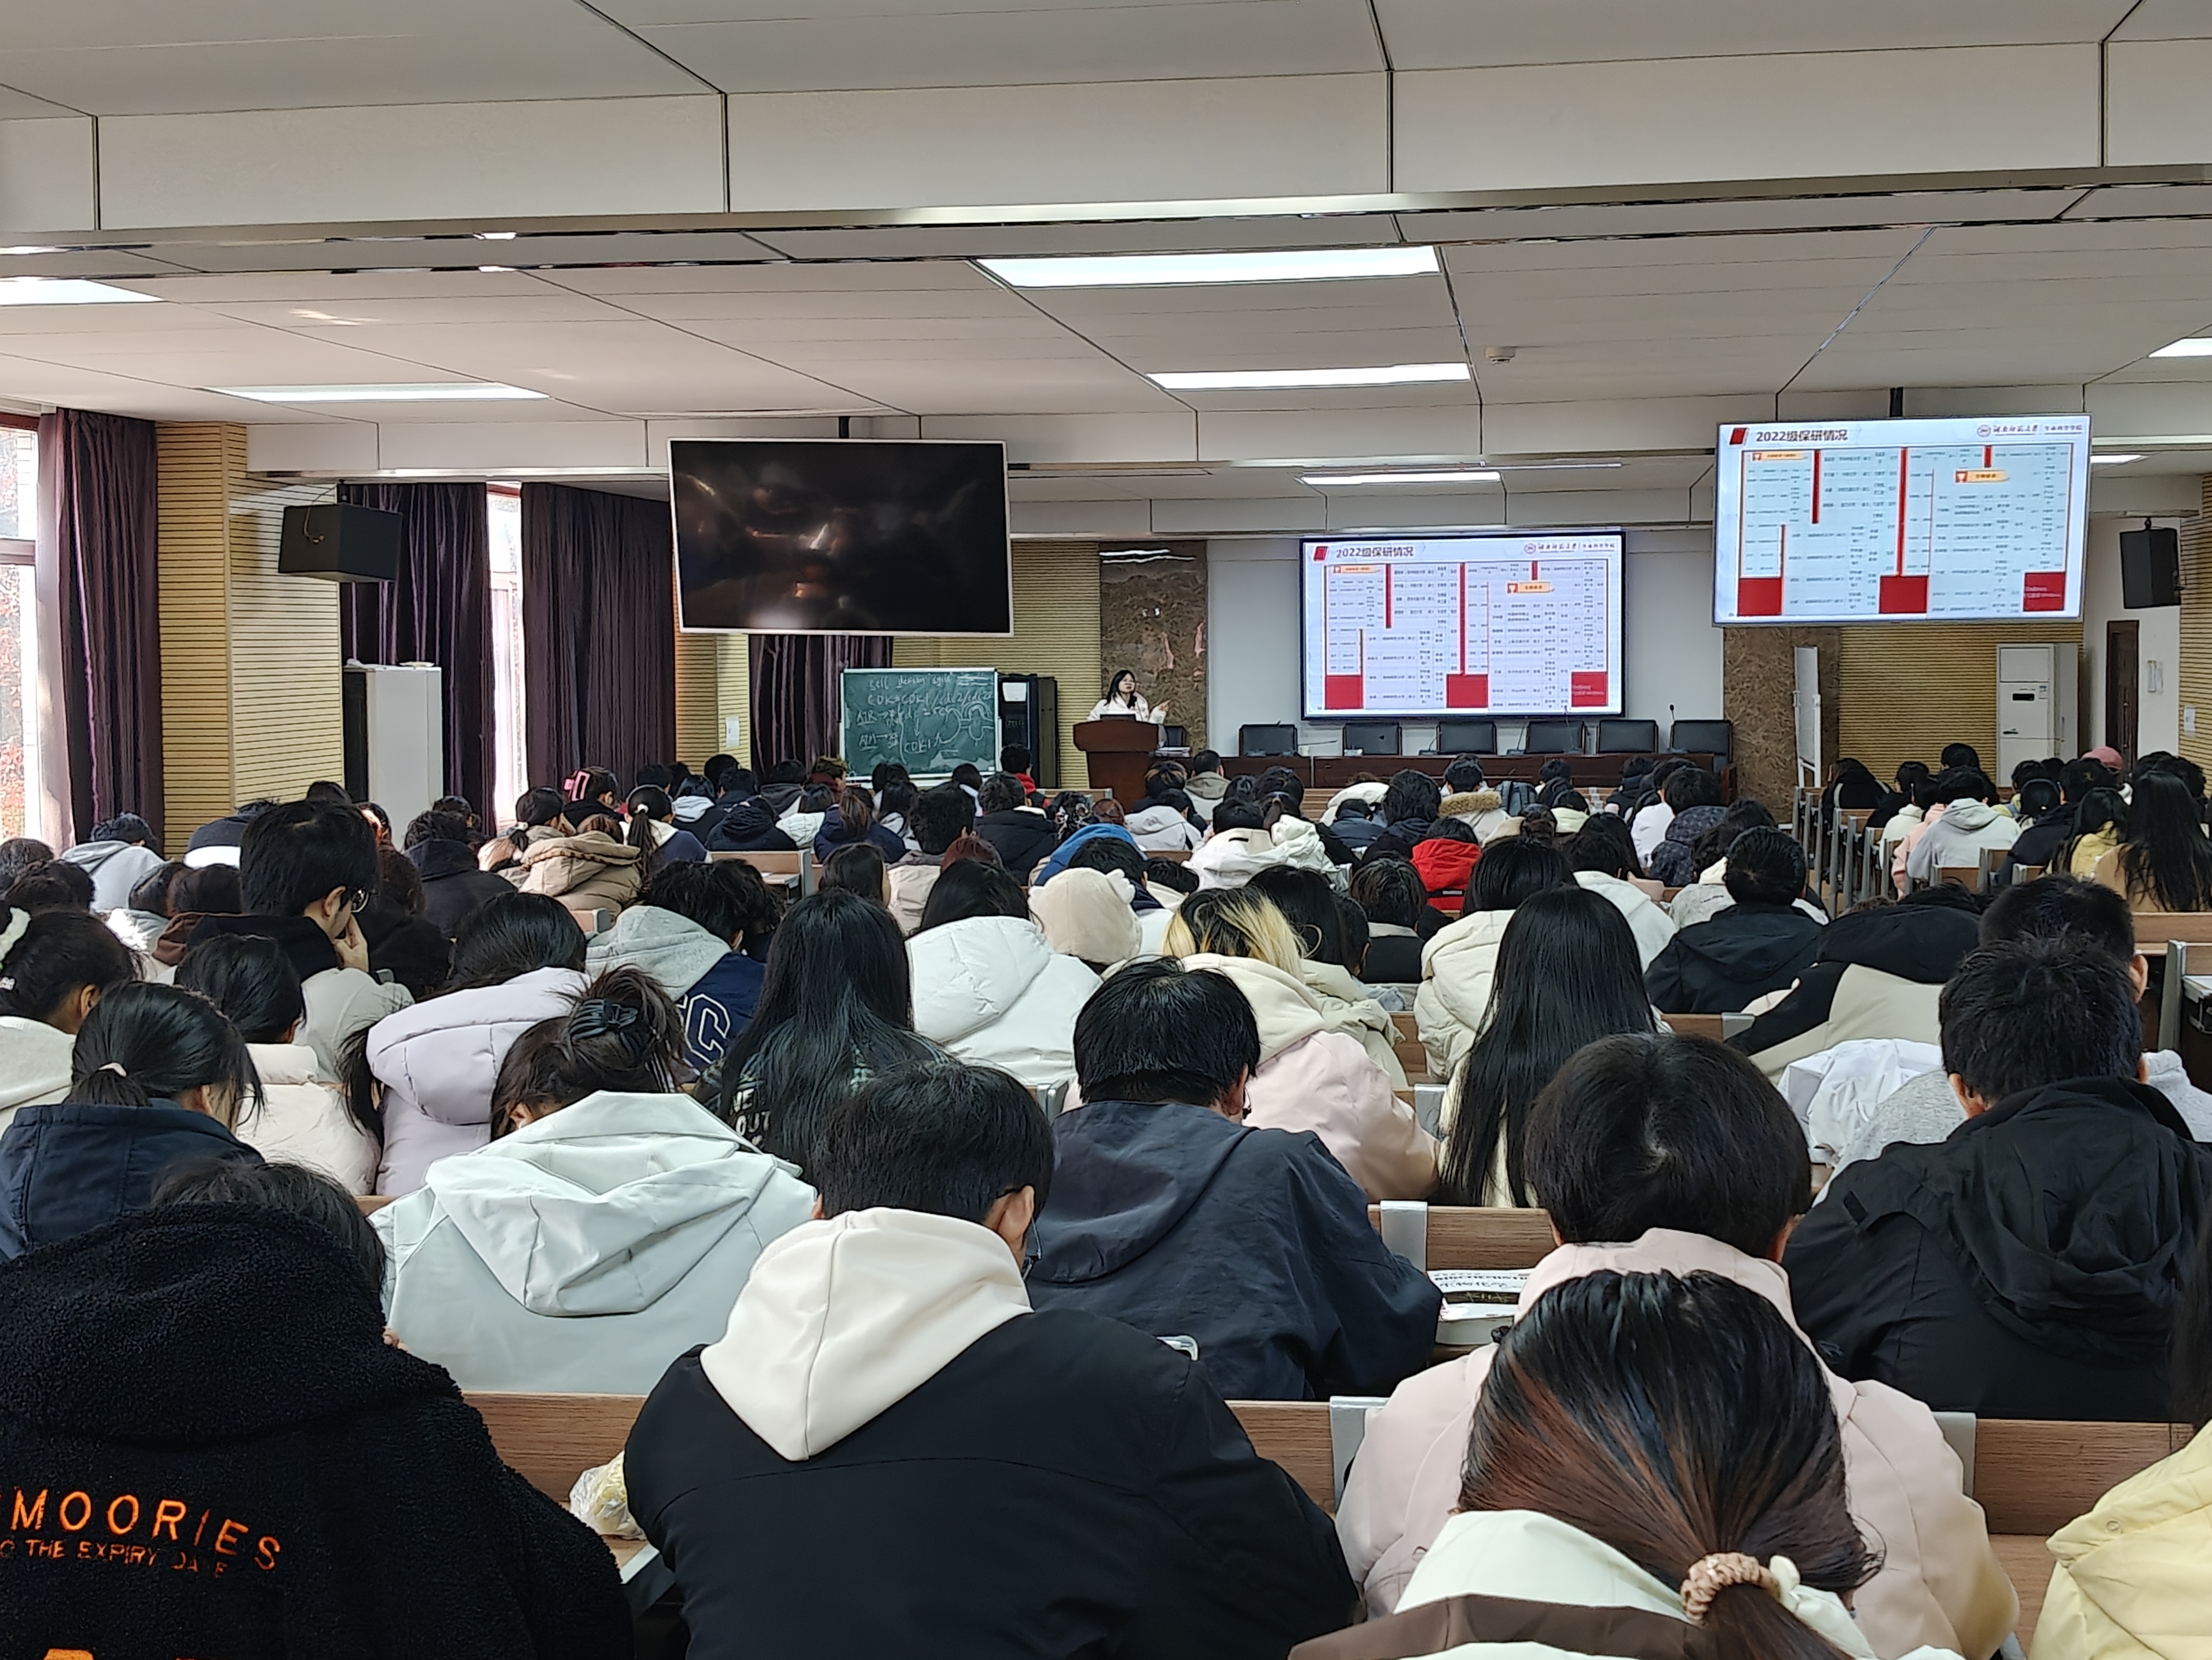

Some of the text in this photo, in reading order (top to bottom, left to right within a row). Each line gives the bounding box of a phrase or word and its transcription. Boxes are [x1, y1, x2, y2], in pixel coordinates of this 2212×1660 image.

[676, 993, 730, 1064] C
[0, 1486, 281, 1571] MOORIES
[25, 1539, 65, 1559] THE
[78, 1540, 159, 1567] EXPIRY
